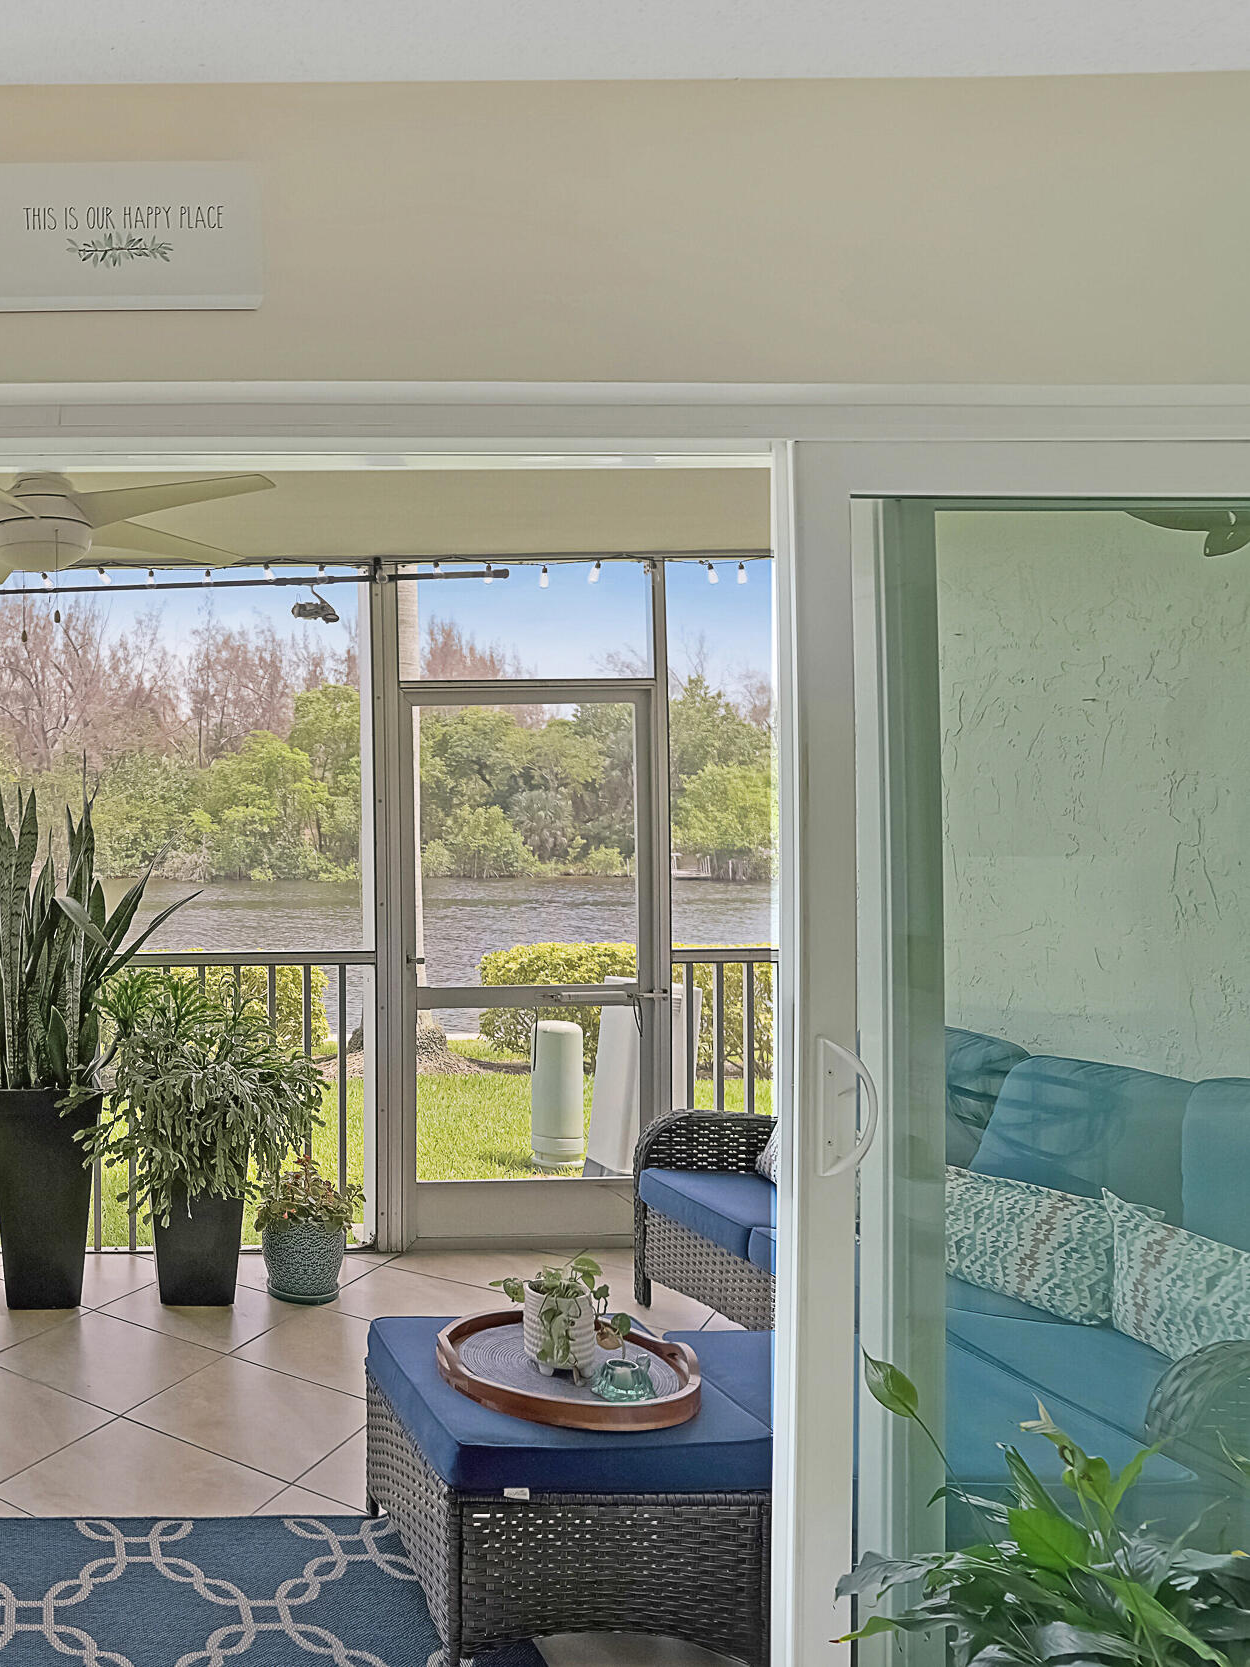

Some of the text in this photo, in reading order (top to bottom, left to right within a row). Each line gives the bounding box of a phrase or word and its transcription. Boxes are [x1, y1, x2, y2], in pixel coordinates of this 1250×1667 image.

[23, 205, 224, 230] THIS IS OUR HAPPY PLACE
